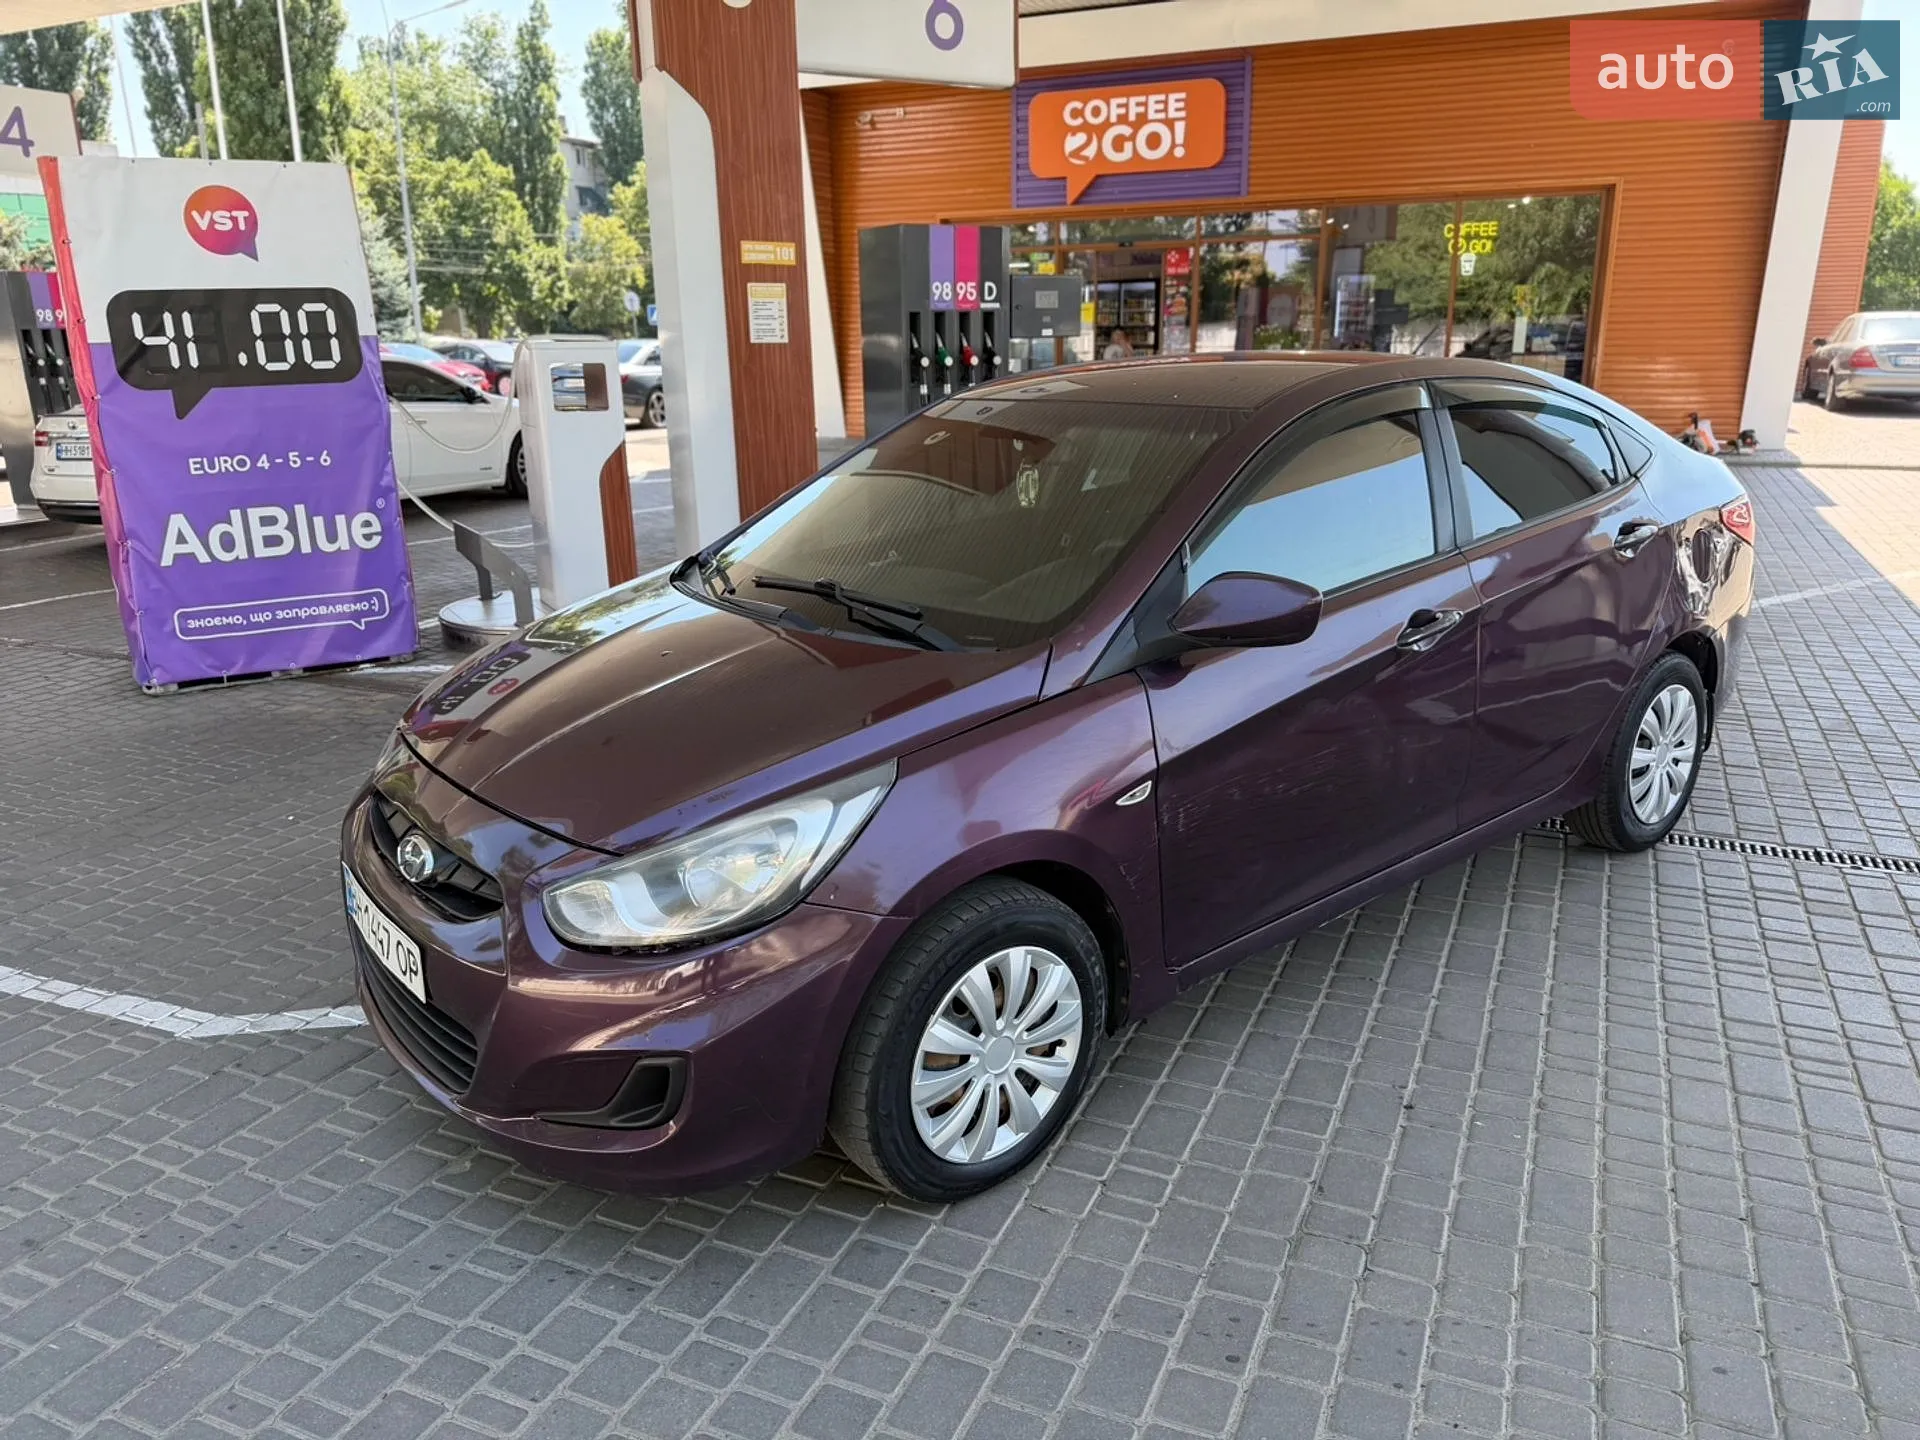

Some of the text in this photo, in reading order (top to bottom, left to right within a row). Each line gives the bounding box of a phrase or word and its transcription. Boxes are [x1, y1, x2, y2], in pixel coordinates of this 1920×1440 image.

[925, 0, 964, 51] 6
[1062, 92, 1187, 127] COFFEE
[0, 105, 35, 158] 4
[190, 209, 250, 231] VST
[932, 281, 997, 301] 98 95 D
[36, 308, 53, 322] 98
[188, 455, 251, 475] EURO
[256, 453, 270, 470] 4
[288, 452, 301, 468] 5
[319, 450, 331, 466] 6
[186, 614, 247, 629] знаємо,
[249, 611, 272, 624] що
[275, 601, 369, 619] заправляємо
[396, 939, 419, 983] OP
